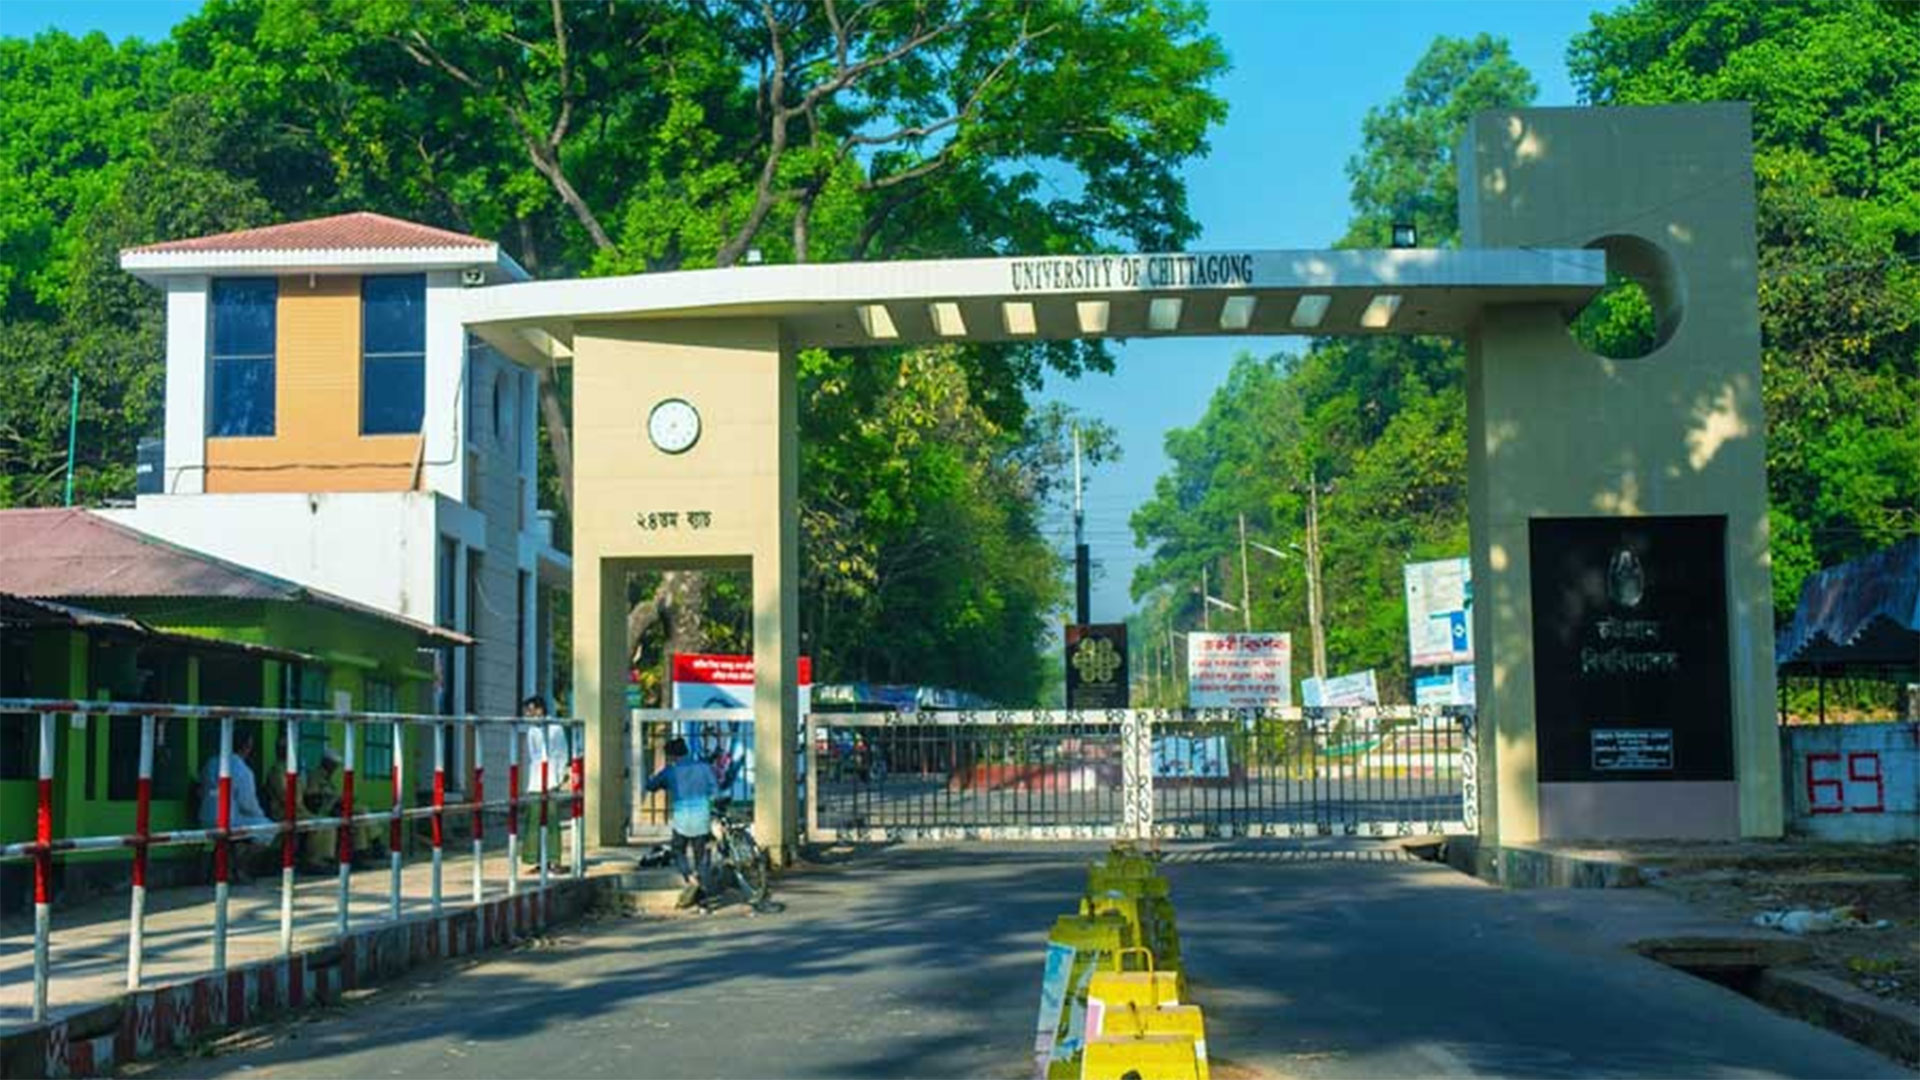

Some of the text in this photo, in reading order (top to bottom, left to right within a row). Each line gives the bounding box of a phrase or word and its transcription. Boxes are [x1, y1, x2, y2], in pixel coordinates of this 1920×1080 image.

[1121, 257, 1141, 287] OF
[1147, 253, 1254, 286] CHITTAGONG
[1807, 752, 1884, 814] 69
